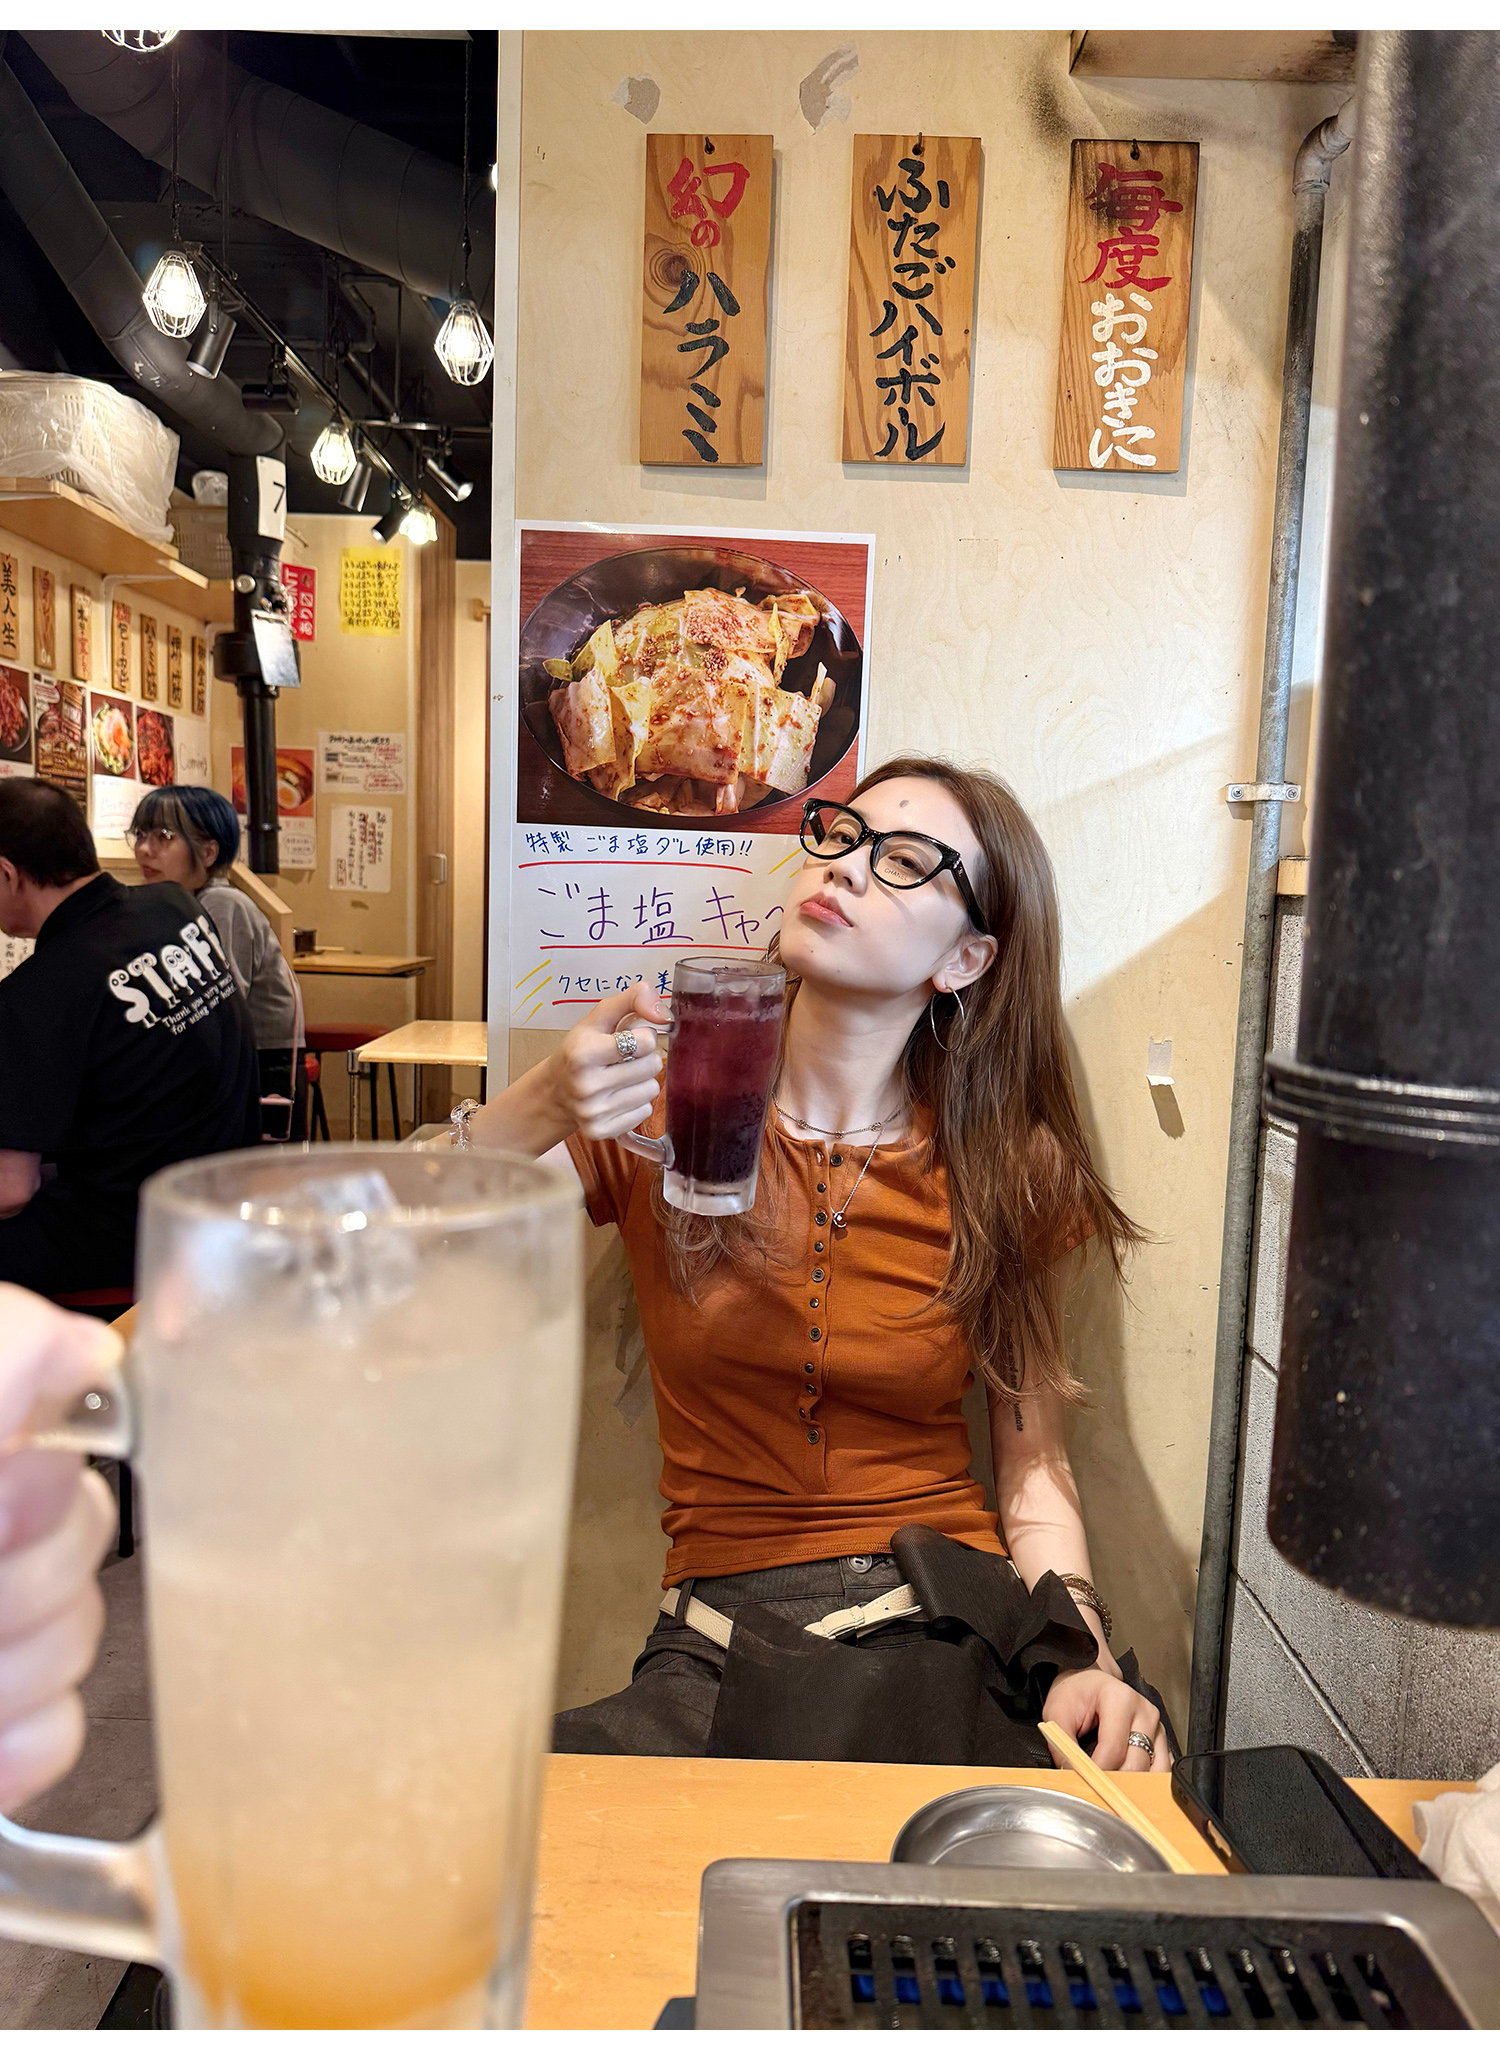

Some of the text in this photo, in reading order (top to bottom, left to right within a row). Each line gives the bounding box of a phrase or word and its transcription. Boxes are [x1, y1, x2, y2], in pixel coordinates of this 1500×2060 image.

[663, 157, 750, 463] 幻のハラミ
[868, 158, 951, 463] ふたごハイボール
[1079, 162, 1184, 469] 毎度おおきに
[273, 482, 286, 513] 7
[884, 867, 908, 881] CHANEL
[162, 1005, 191, 1027] Thank
[190, 997, 205, 1011] you
[171, 1021, 187, 1035] for
[188, 1006, 210, 1024] using
